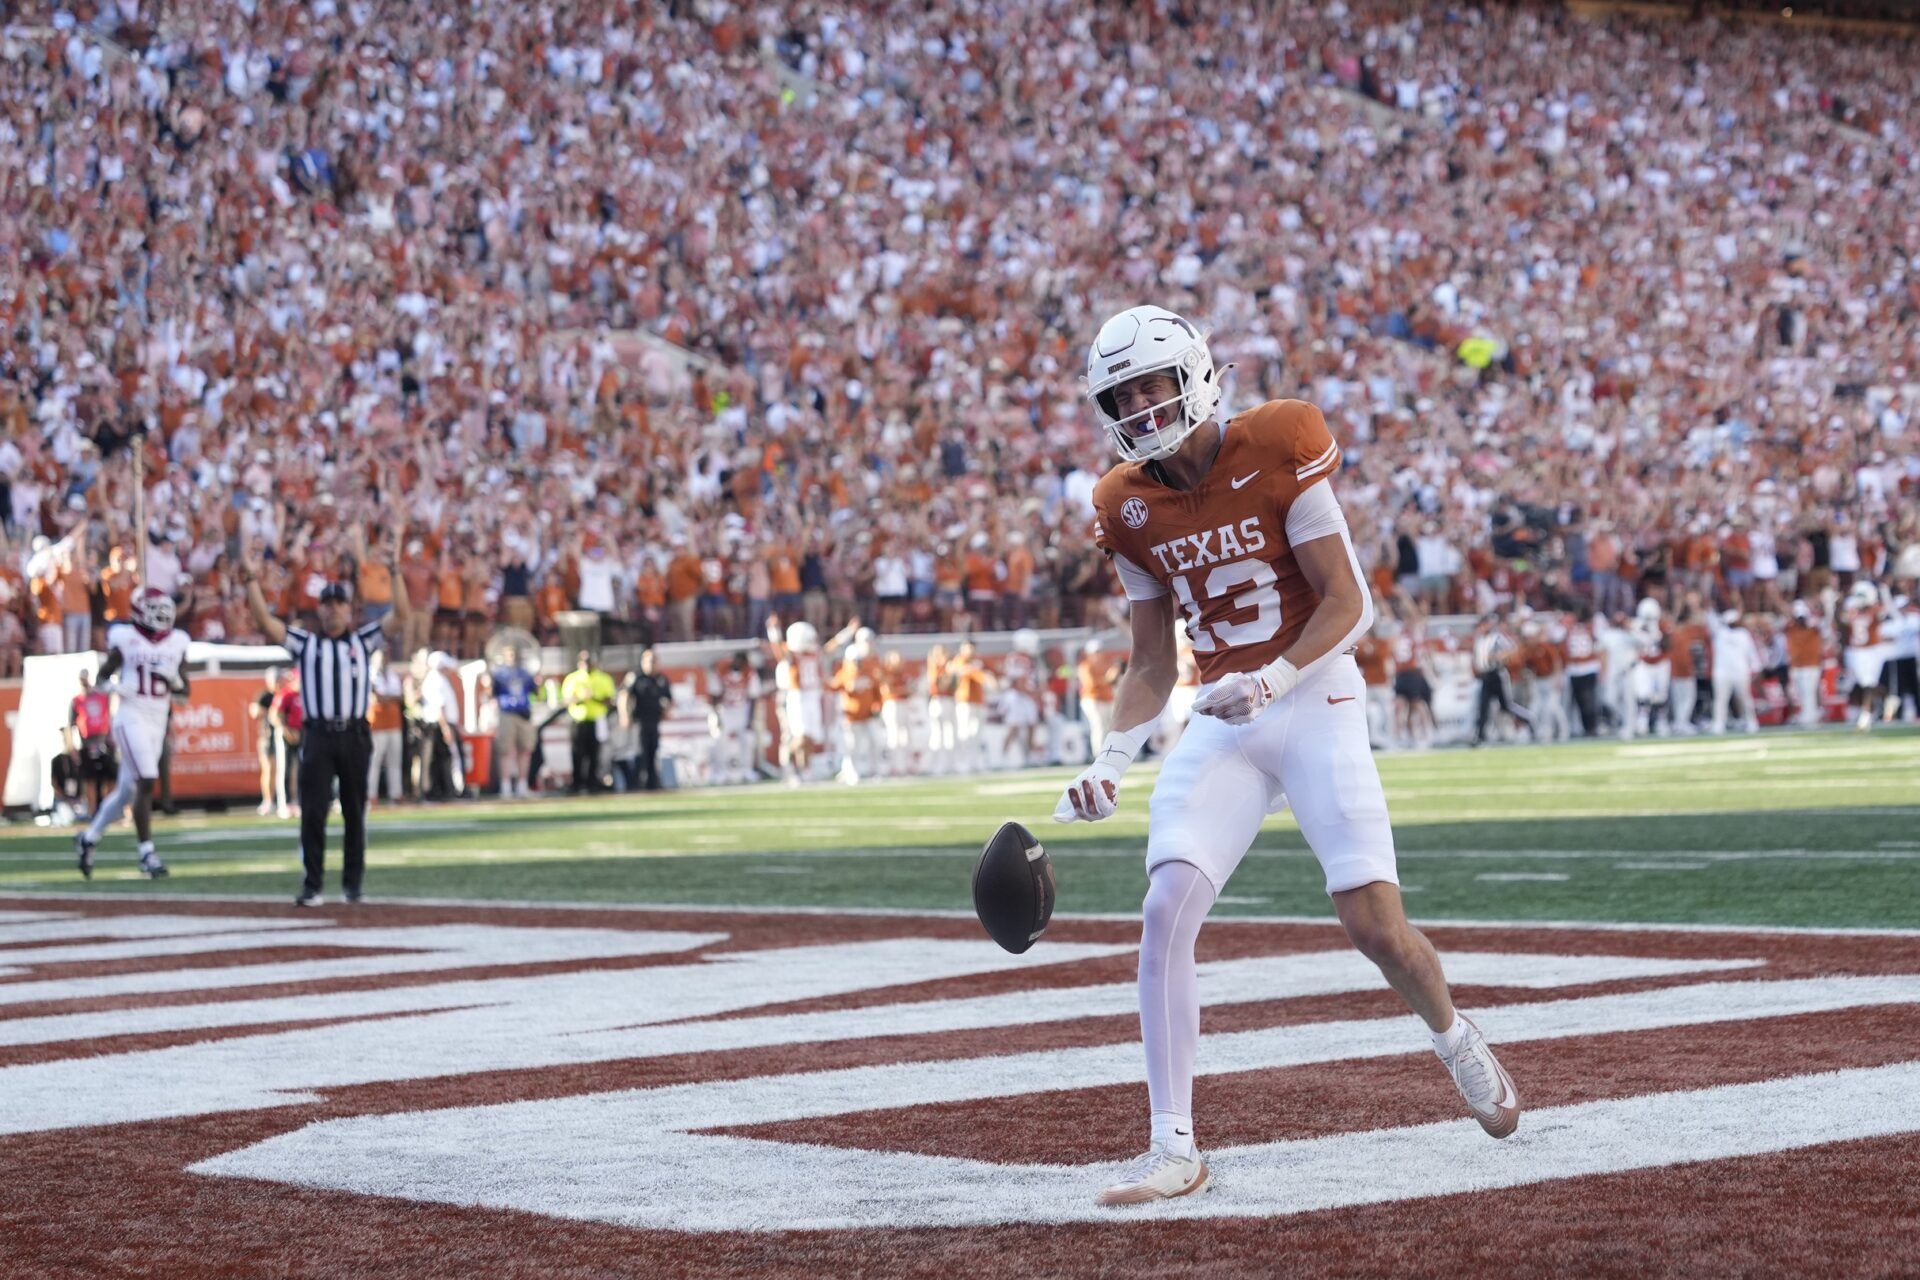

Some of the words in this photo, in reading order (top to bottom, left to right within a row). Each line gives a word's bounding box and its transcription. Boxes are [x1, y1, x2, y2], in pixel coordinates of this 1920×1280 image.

[1107, 359, 1131, 375] HORNS
[1122, 499, 1147, 527] SEC
[1150, 516, 1265, 573] TEXAS
[1172, 557, 1283, 652] 13
